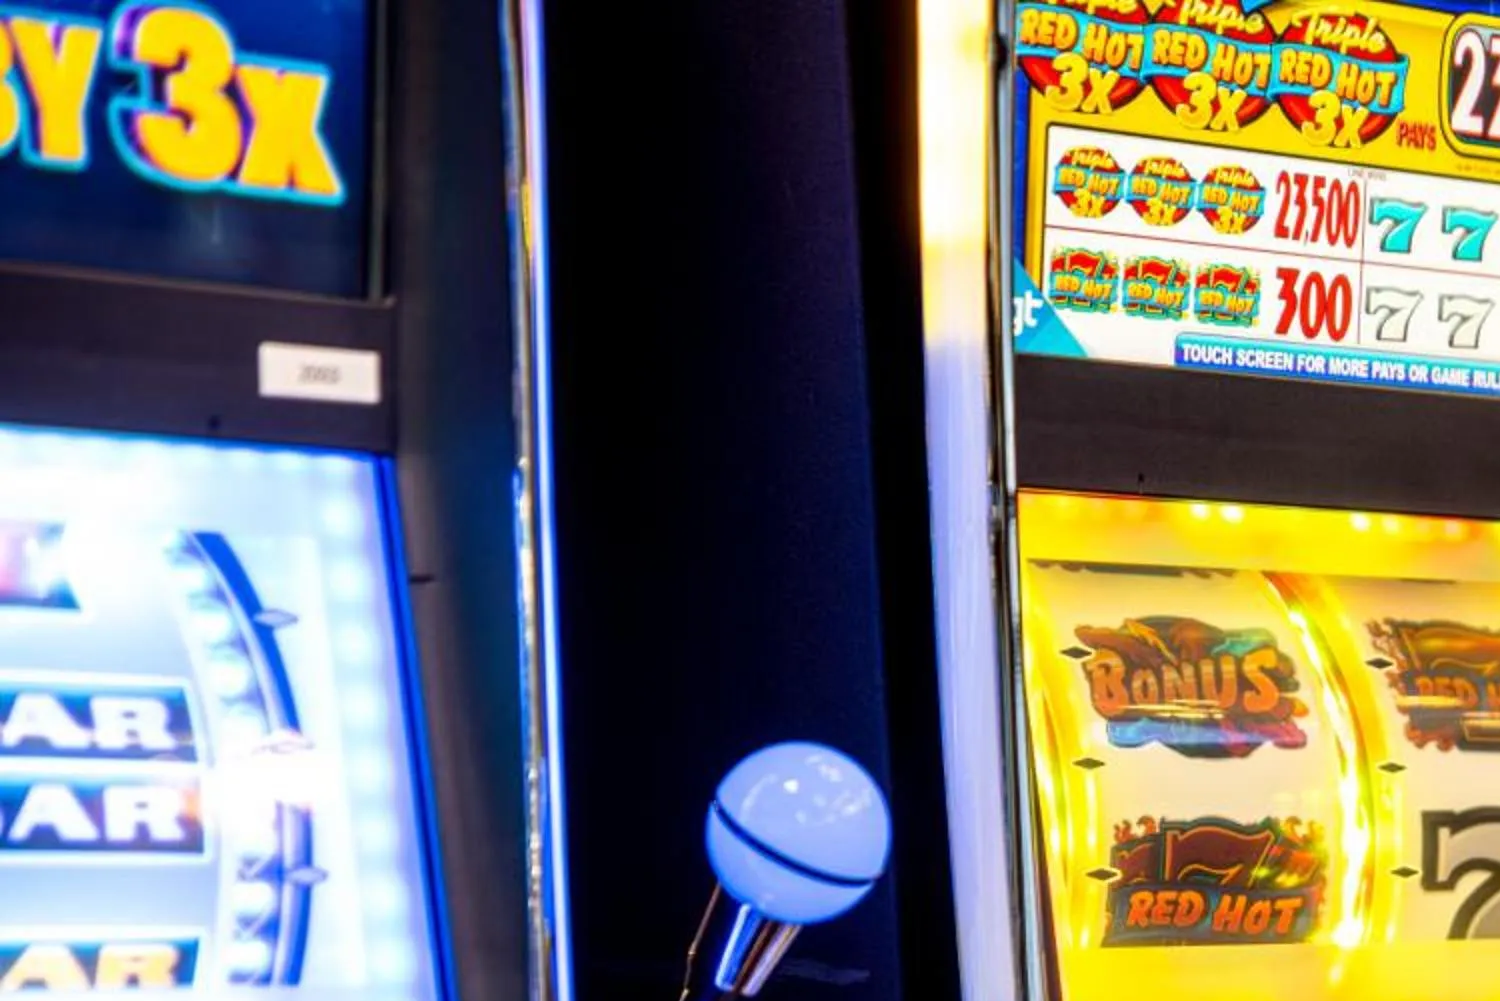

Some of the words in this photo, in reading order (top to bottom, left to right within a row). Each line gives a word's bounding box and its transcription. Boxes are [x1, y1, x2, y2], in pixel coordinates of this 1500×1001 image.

[1021, 9, 1077, 50] RED
[1083, 23, 1143, 69] HOT
[1152, 29, 1206, 68] RED
[1212, 44, 1271, 88] HOT
[1293, 9, 1386, 53] Triple
[1280, 48, 1331, 88] RED
[1336, 63, 1397, 110] HOT
[1396, 119, 1436, 150] PAYS
[1369, 197, 1428, 254] 7
[1442, 206, 1498, 262] 7
[1275, 266, 1352, 341] 300
[1182, 343, 1233, 364] TOUCH
[1236, 349, 1293, 371] SCREEN
[1297, 354, 1325, 373] FOR
[1329, 356, 1368, 379] MORE
[1372, 361, 1405, 382] PAYS
[1409, 366, 1428, 383] OR
[1431, 366, 1469, 386] GAME
[1127, 889, 1205, 929] RED
[1213, 895, 1303, 935] HOT
